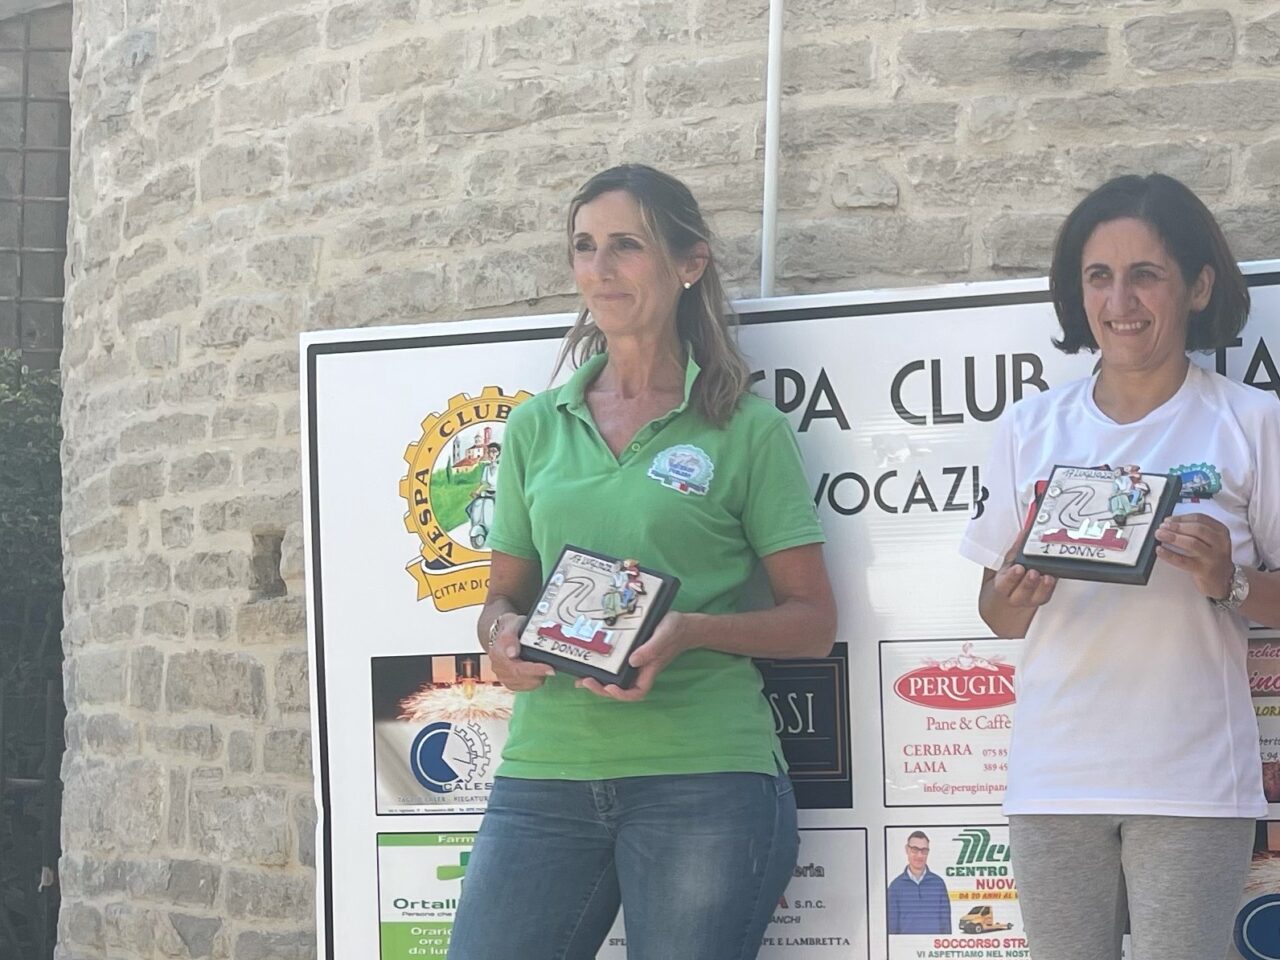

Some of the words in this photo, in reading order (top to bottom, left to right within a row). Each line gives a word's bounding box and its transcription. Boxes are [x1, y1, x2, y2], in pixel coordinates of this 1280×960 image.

[890, 352, 1050, 426] CLUB
[413, 467, 454, 559] VESPA
[438, 403, 513, 438] CLUB
[1059, 544, 1106, 559] DONNE
[433, 579, 468, 600] CITTA'
[470, 579, 484, 590] DI
[550, 640, 593, 661] DONNE
[926, 716, 956, 731] Pane
[959, 716, 972, 730] &
[975, 713, 1012, 730] Caffè
[903, 743, 973, 757] CERBARA
[982, 748, 997, 757] 075
[903, 760, 948, 774] LAMA
[983, 762, 997, 772] 389
[437, 834, 475, 843] Farm
[945, 866, 1008, 877] CENTRO
[794, 899, 826, 909] s.n.c.
[785, 936, 851, 947] LAMBRETTA
[933, 938, 1001, 949] SOCCORSO
[408, 946, 427, 955] da
[916, 950, 926, 958] VI
[928, 950, 984, 958] ASPETTIAMO
[986, 950, 1004, 958] NEL
